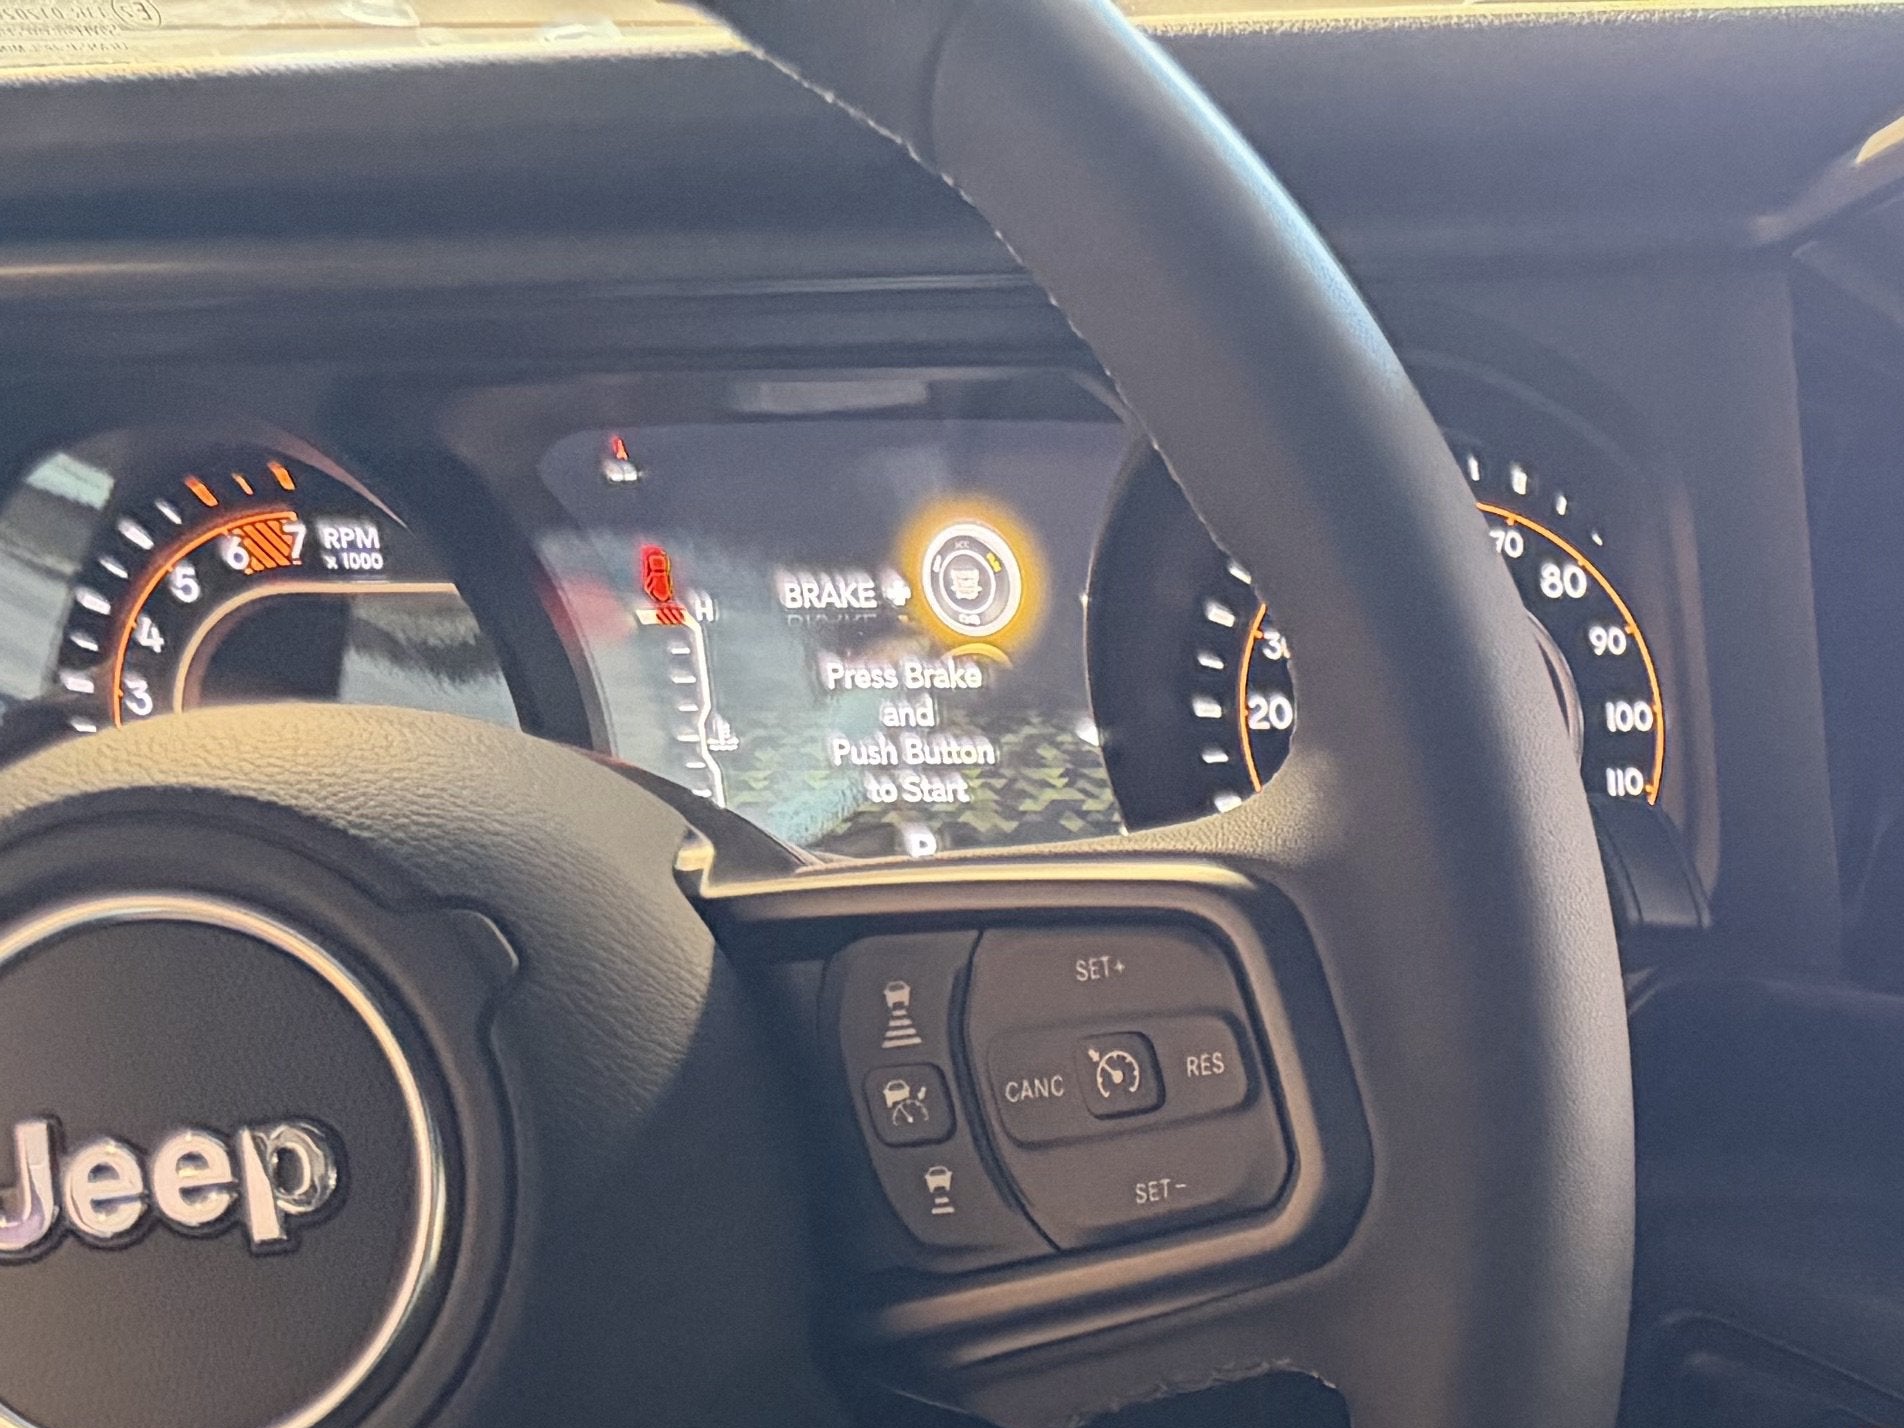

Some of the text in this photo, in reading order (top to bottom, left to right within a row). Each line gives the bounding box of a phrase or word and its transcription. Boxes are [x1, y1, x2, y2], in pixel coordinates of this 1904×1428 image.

[282, 522, 306, 561] 7
[323, 526, 381, 549] RPM
[1488, 529, 1524, 558] 70
[224, 536, 250, 570] 6
[342, 553, 384, 570] 1000
[172, 565, 200, 603] 5
[784, 582, 877, 609] BRAKE
[1540, 562, 1588, 599] 80
[694, 600, 714, 622] H
[136, 615, 164, 653] 4
[1588, 625, 1627, 656] 90
[826, 660, 983, 690] Press Brake
[125, 674, 153, 715] 3
[880, 700, 936, 728] and
[1248, 695, 1293, 730] 20
[1605, 701, 1653, 732] 100
[832, 737, 995, 767] Push Button
[867, 775, 970, 803] to Start
[1606, 767, 1644, 797] 110
[1075, 955, 1126, 982] SET+
[1186, 1052, 1225, 1077] RES
[1005, 1075, 1065, 1103] CANC
[0, 1119, 337, 1251] Jeep
